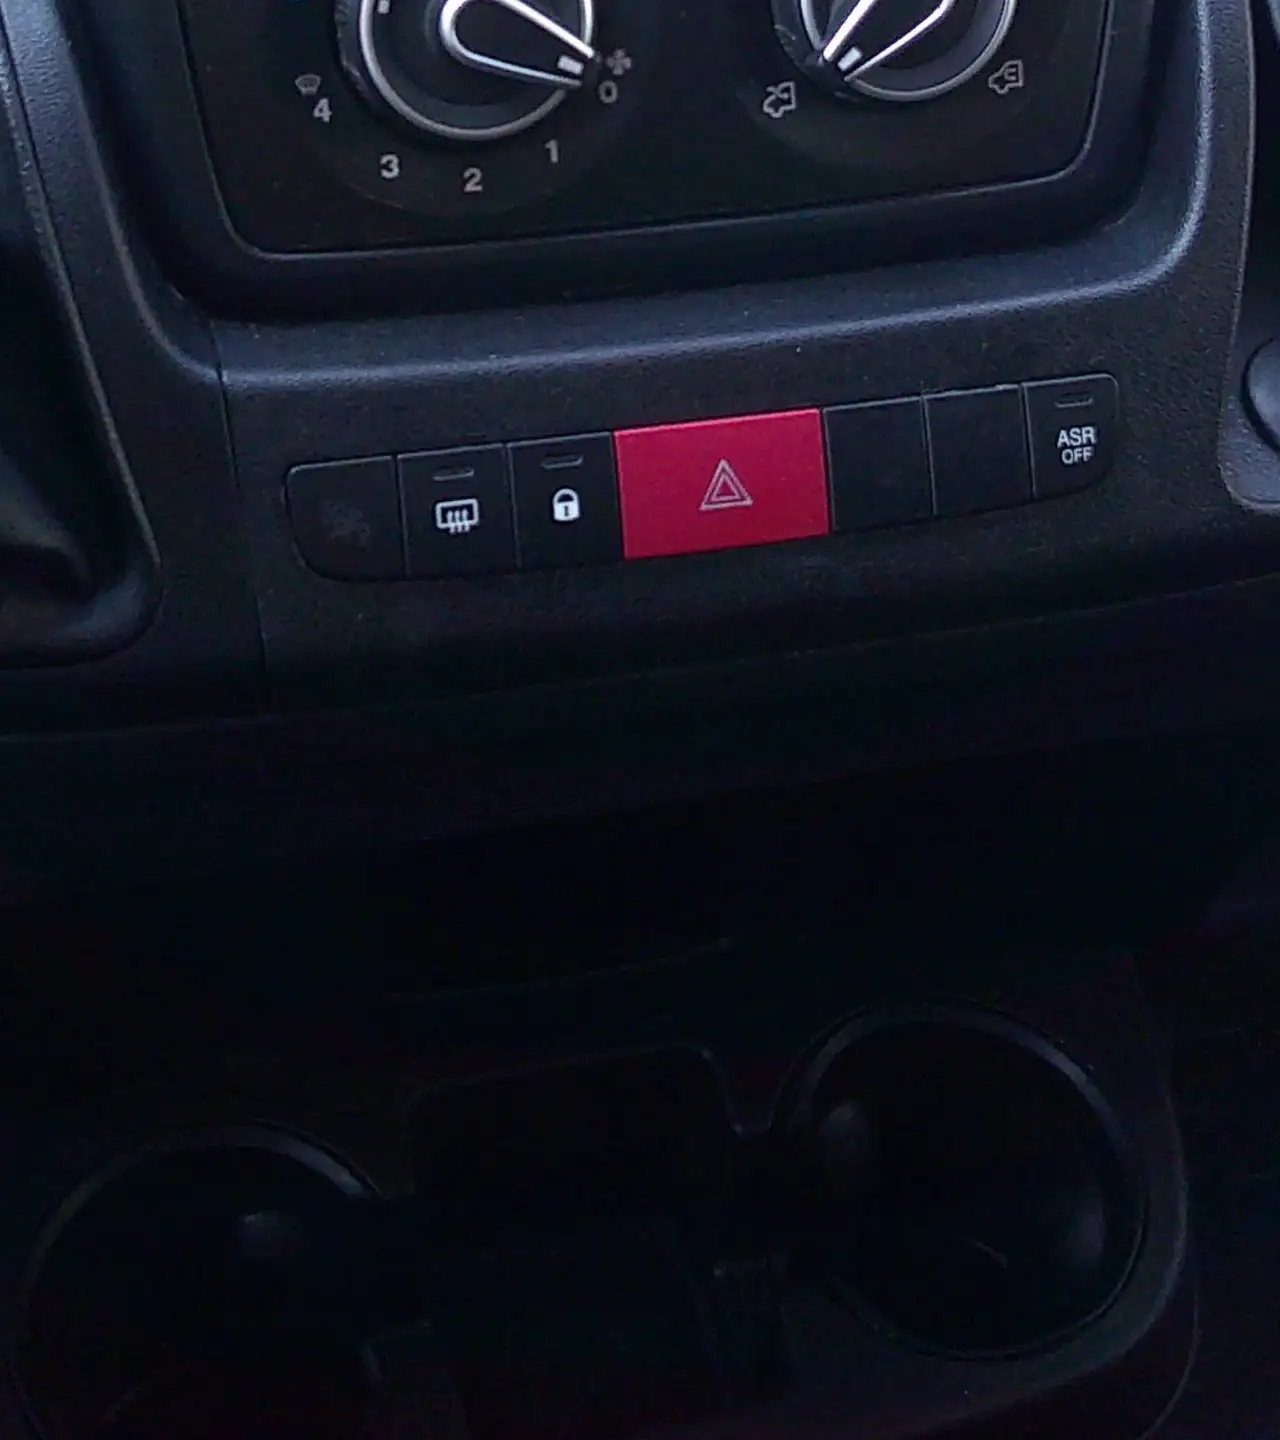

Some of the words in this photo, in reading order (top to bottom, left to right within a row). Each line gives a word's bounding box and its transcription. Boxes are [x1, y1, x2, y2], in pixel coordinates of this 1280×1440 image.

[313, 98, 332, 123] 4
[545, 139, 561, 162] 1
[380, 154, 400, 179] 3
[463, 168, 483, 192] 2
[1057, 426, 1096, 447] ASR
[1061, 446, 1092, 464] OFF
